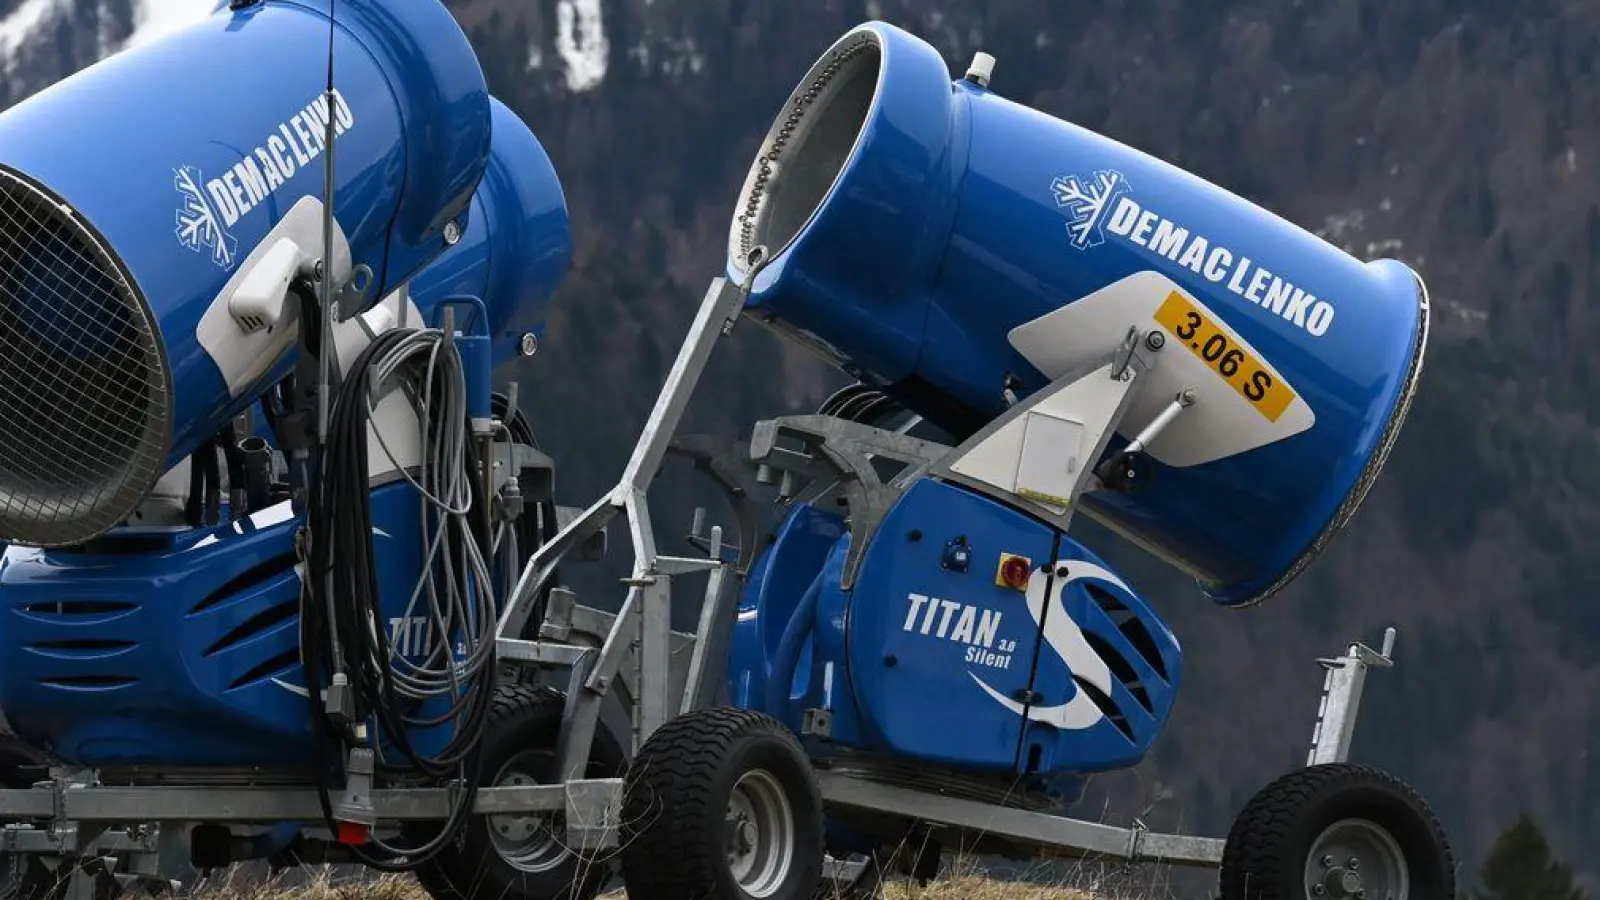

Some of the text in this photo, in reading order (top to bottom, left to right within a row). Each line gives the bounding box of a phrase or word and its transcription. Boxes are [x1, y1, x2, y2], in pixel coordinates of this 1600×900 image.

[1176, 311, 1272, 401] 3.06 S
[903, 593, 1016, 652] TITAN 3.0
[965, 646, 1011, 669] Silent
